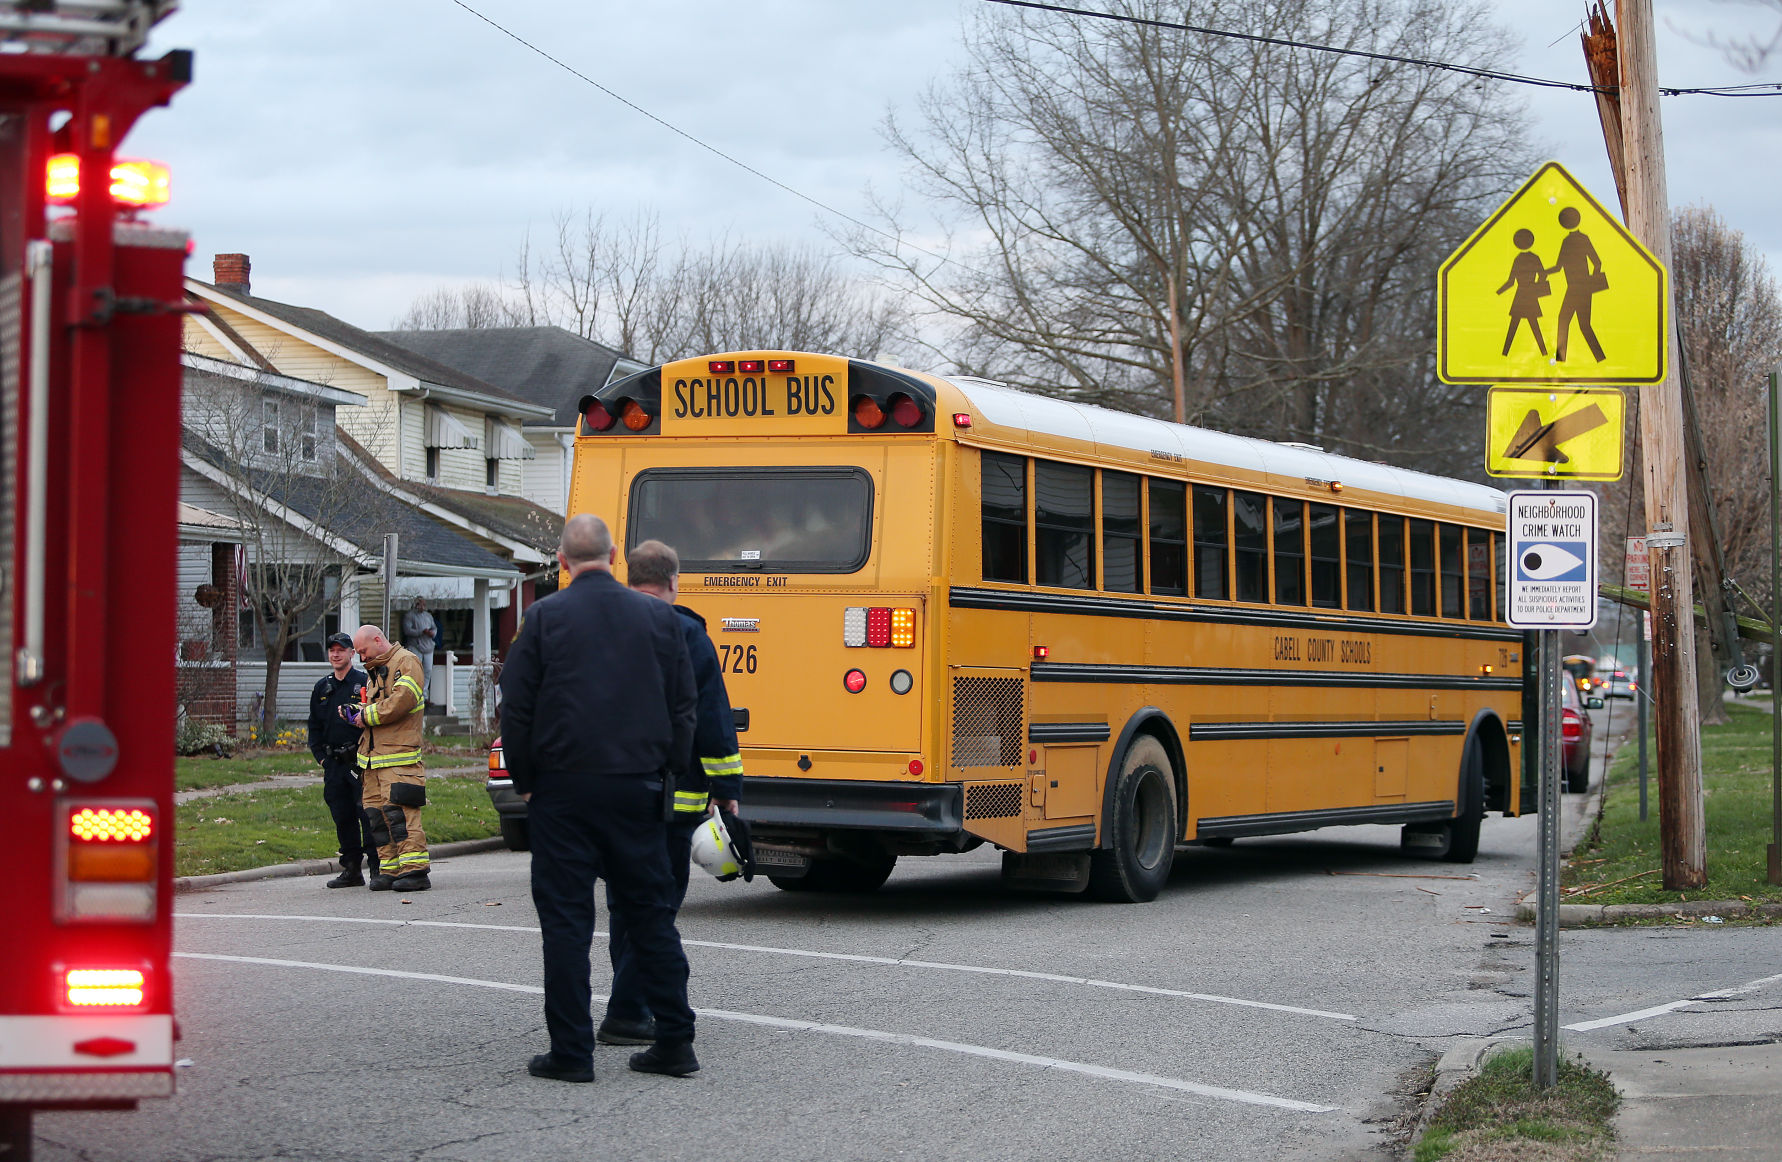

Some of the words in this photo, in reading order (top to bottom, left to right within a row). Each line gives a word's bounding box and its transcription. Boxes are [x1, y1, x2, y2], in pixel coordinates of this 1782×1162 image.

[674, 377, 775, 418] SCHOOL
[786, 375, 835, 416] BUS
[1518, 505, 1586, 519] NEIGHBORHOOD
[1522, 523, 1548, 538] CRIME
[1551, 523, 1581, 538] WATCH
[1633, 542, 1644, 552] NO
[704, 576, 760, 587] EMERGENCY
[766, 576, 788, 587] EXIT
[1530, 585, 1561, 593] IMMEDIATELY
[1529, 595, 1557, 603] SUSPICIOUS
[1559, 595, 1585, 603] ACTIVITIES
[1524, 605, 1535, 613] OUR
[721, 617, 760, 629] Thomas
[1275, 636, 1301, 661] CABELL
[1308, 638, 1335, 662] COUNTY
[1341, 639, 1371, 664] SCHOOLS
[720, 645, 757, 674] 726
